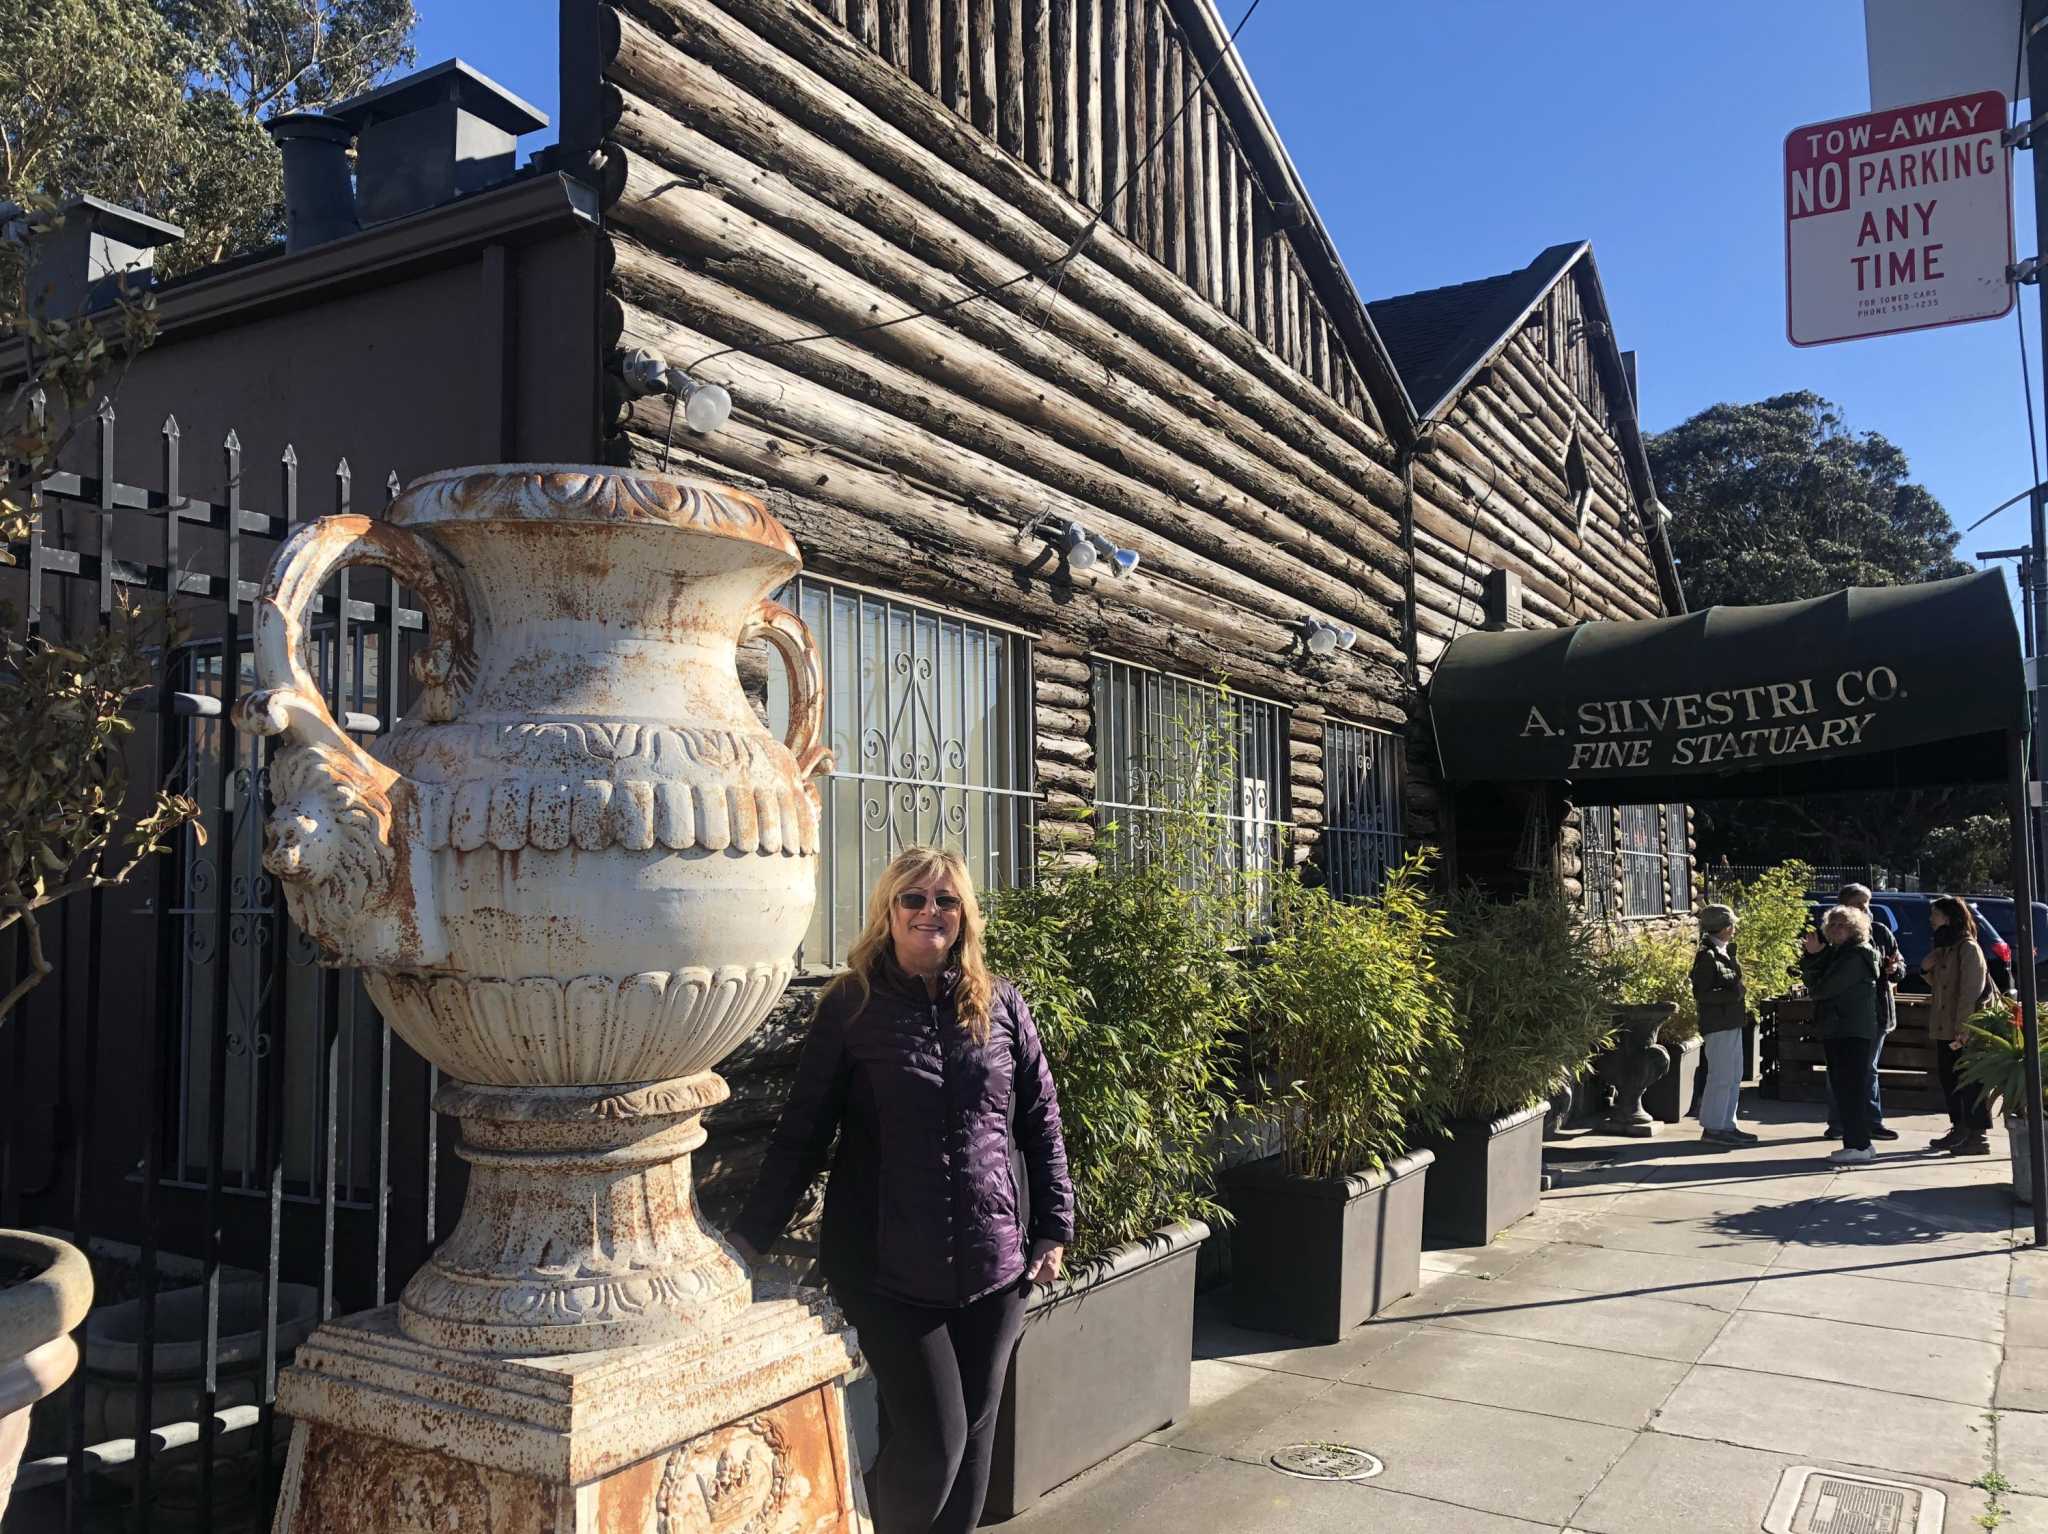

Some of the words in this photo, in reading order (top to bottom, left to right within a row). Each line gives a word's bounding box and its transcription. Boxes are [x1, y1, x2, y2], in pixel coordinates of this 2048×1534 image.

[1806, 102, 1984, 158] TOW-AWAY
[1791, 161, 1843, 216] NO
[1859, 138, 1995, 197] PARKING
[1856, 199, 1939, 247] ANY
[1851, 243, 1945, 291] TIME
[1880, 293, 1910, 304] TOWED
[1519, 704, 1566, 738] A.
[1577, 678, 1818, 736] SILVESTRI
[1836, 665, 1909, 707] CO.
[1567, 739, 1653, 770] FINE
[1672, 712, 1876, 765] STATUARY
